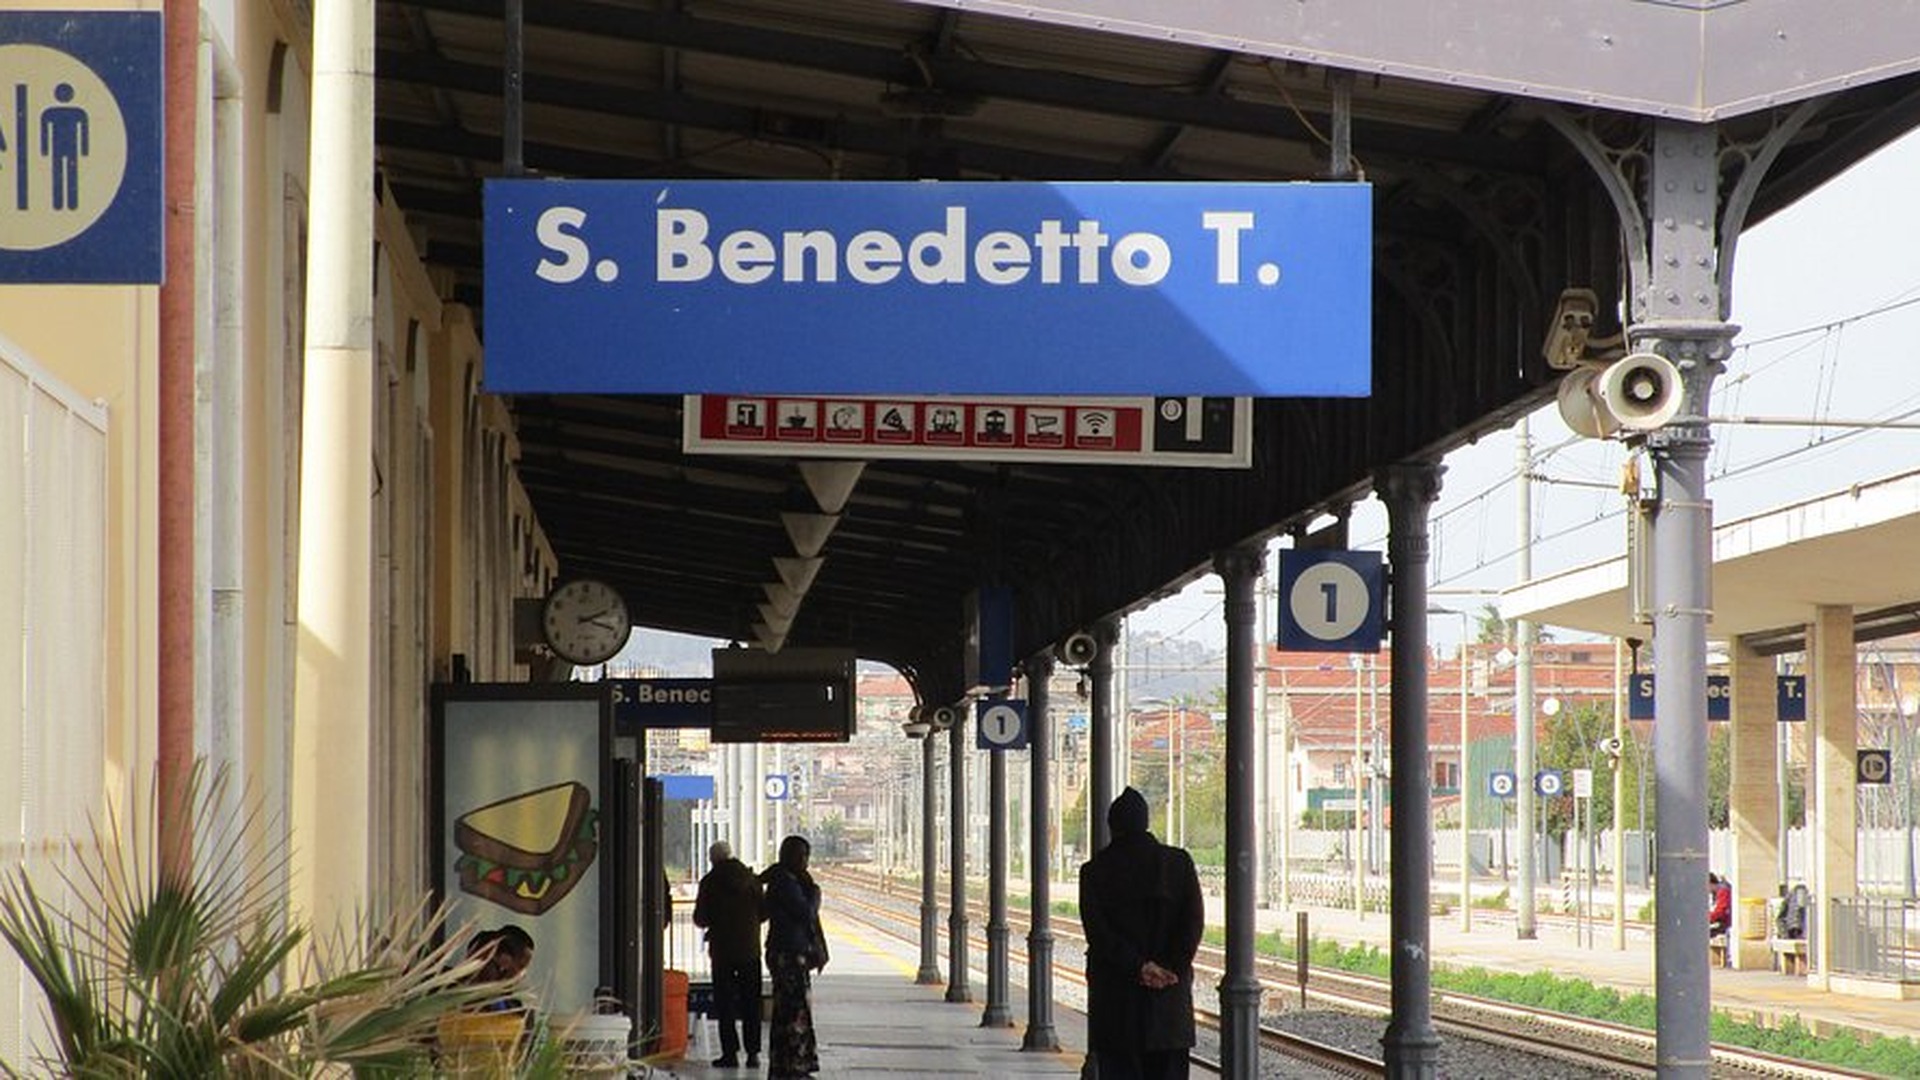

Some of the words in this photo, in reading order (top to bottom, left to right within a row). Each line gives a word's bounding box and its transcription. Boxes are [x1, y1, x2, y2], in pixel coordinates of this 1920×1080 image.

[536, 206, 618, 283] S.
[657, 206, 1172, 286] Benedetto
[1202, 210, 1280, 286] T.
[1320, 582, 1338, 623] 1
[611, 683, 631, 703] S.
[826, 685, 833, 701] 1
[1784, 680, 1803, 699] T.
[996, 714, 1005, 736] 1
